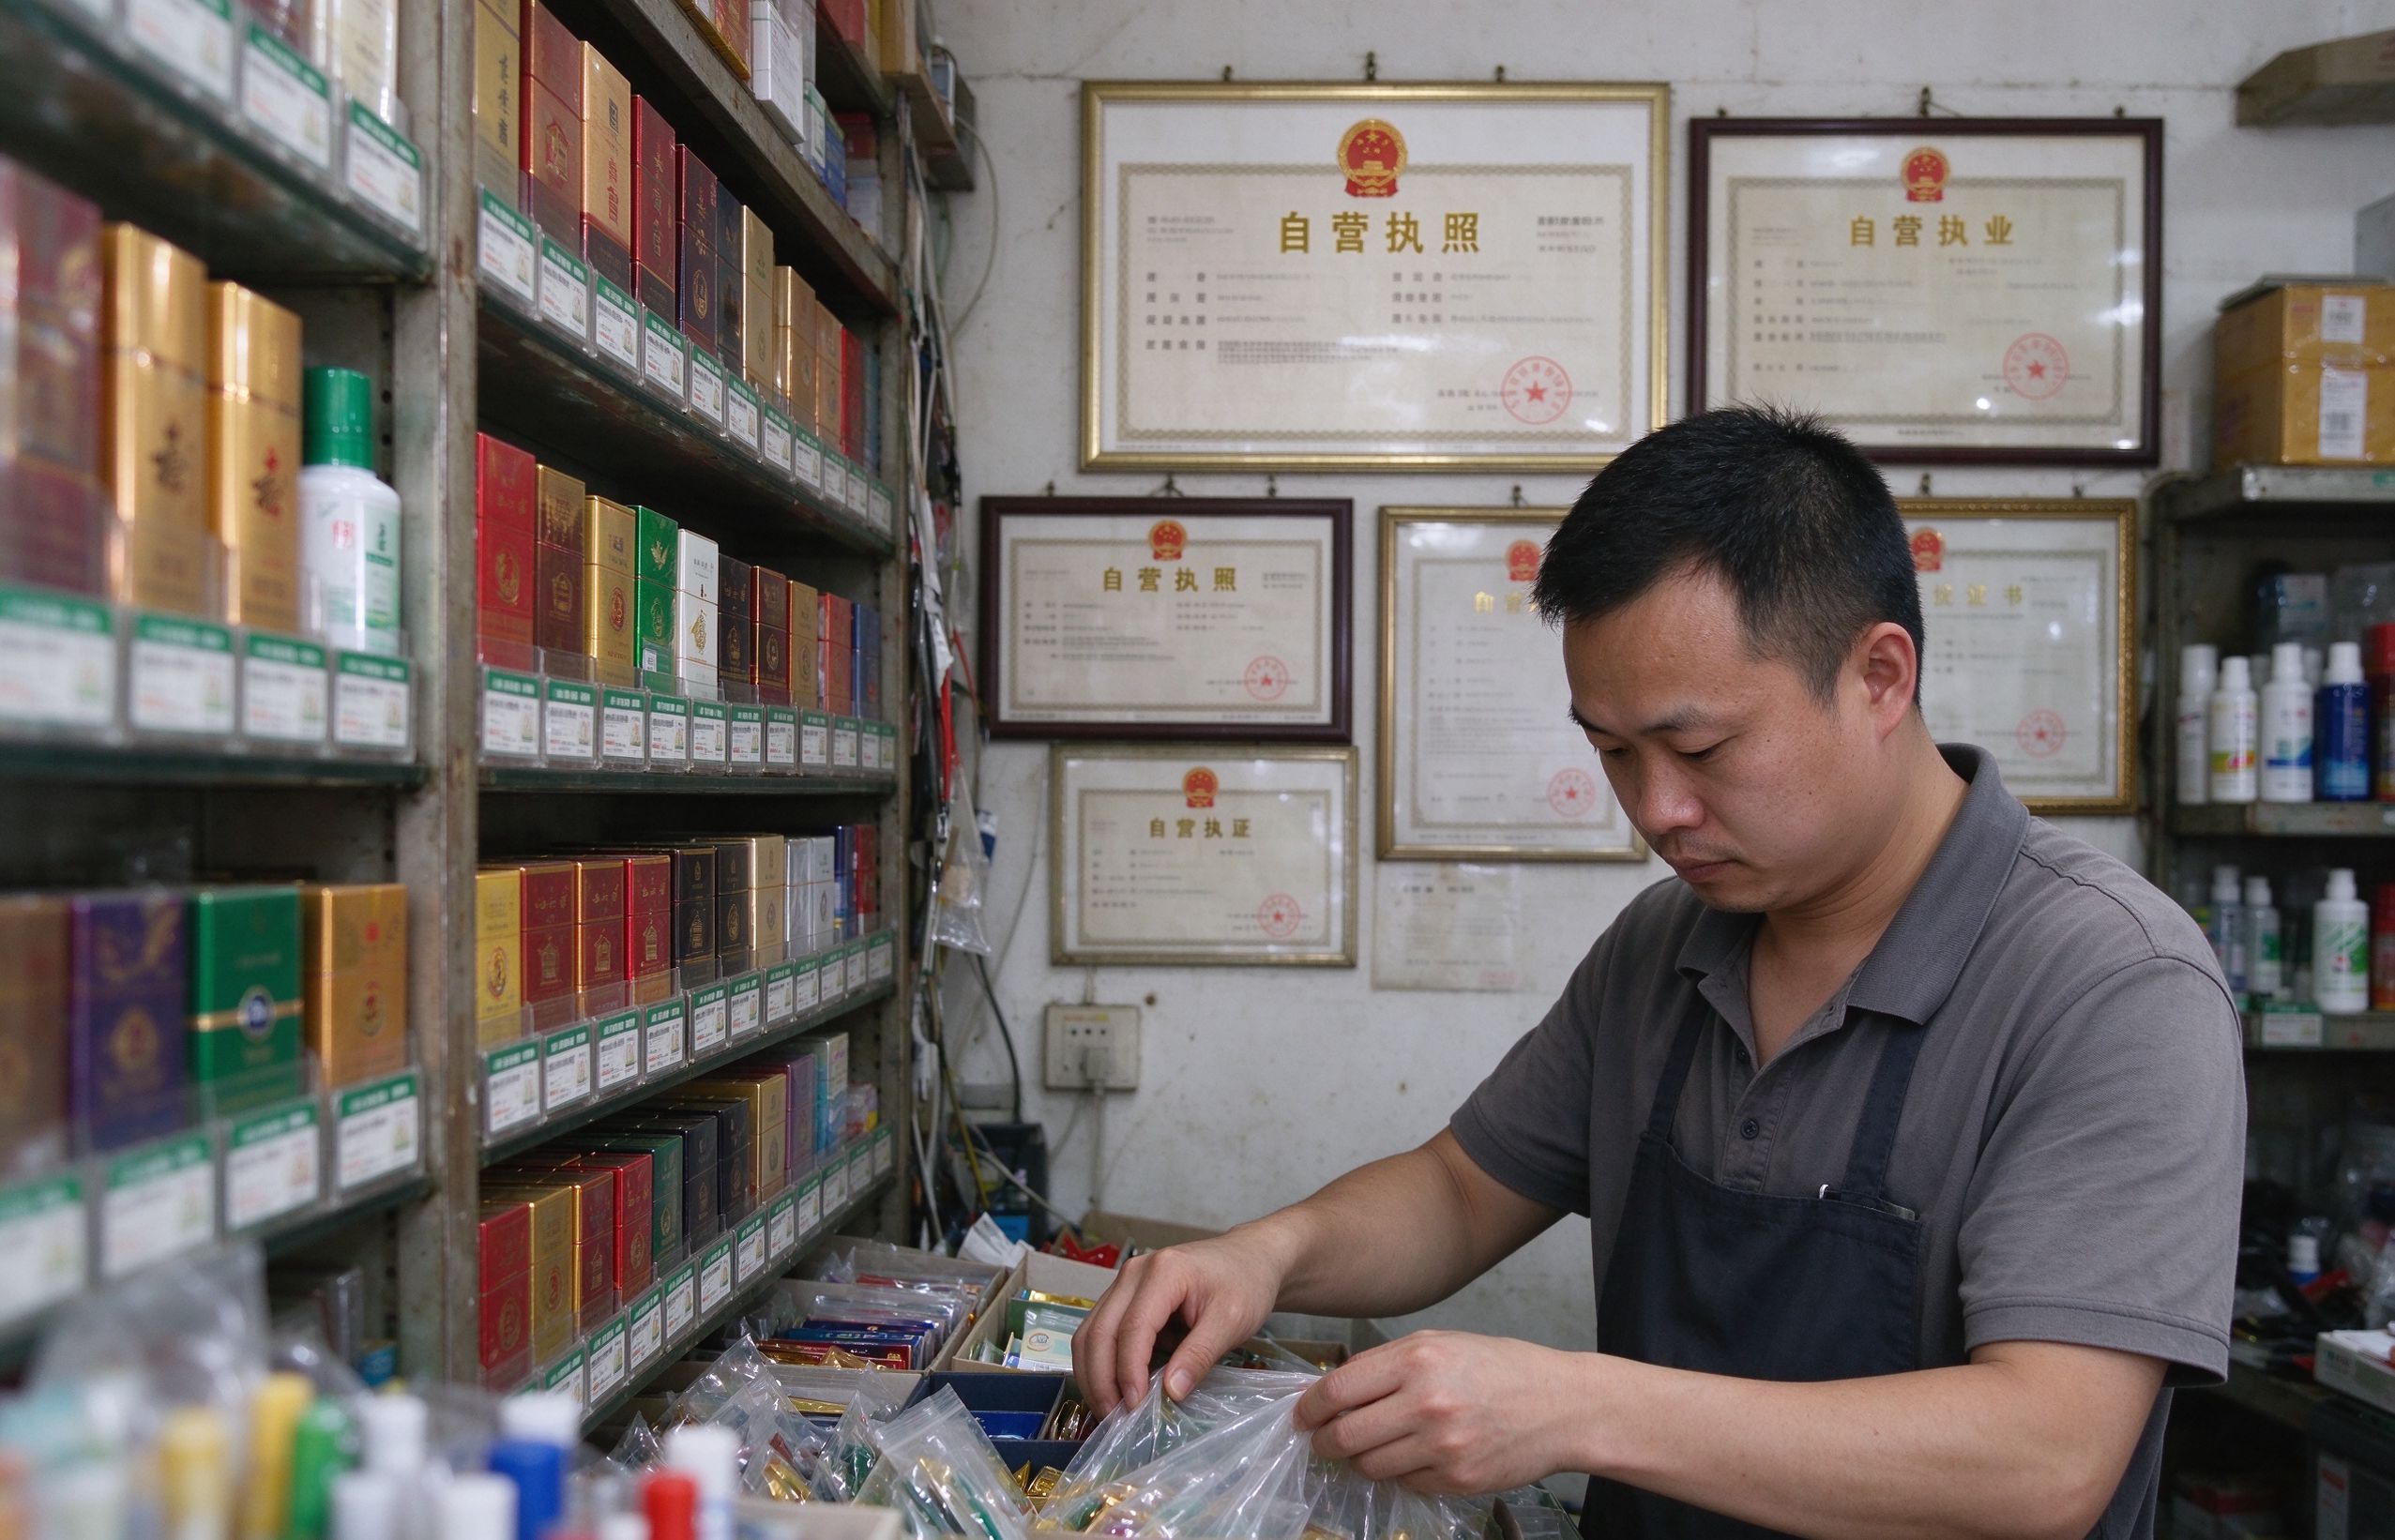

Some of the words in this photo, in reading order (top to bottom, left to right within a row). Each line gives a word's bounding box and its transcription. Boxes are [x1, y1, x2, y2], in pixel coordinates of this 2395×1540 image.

[1280, 211, 1479, 254] 自营执照
[1850, 215, 2014, 247] 自营执业
[1102, 567, 1237, 593] 自营执照
[1149, 817, 1252, 838] 自营执证
